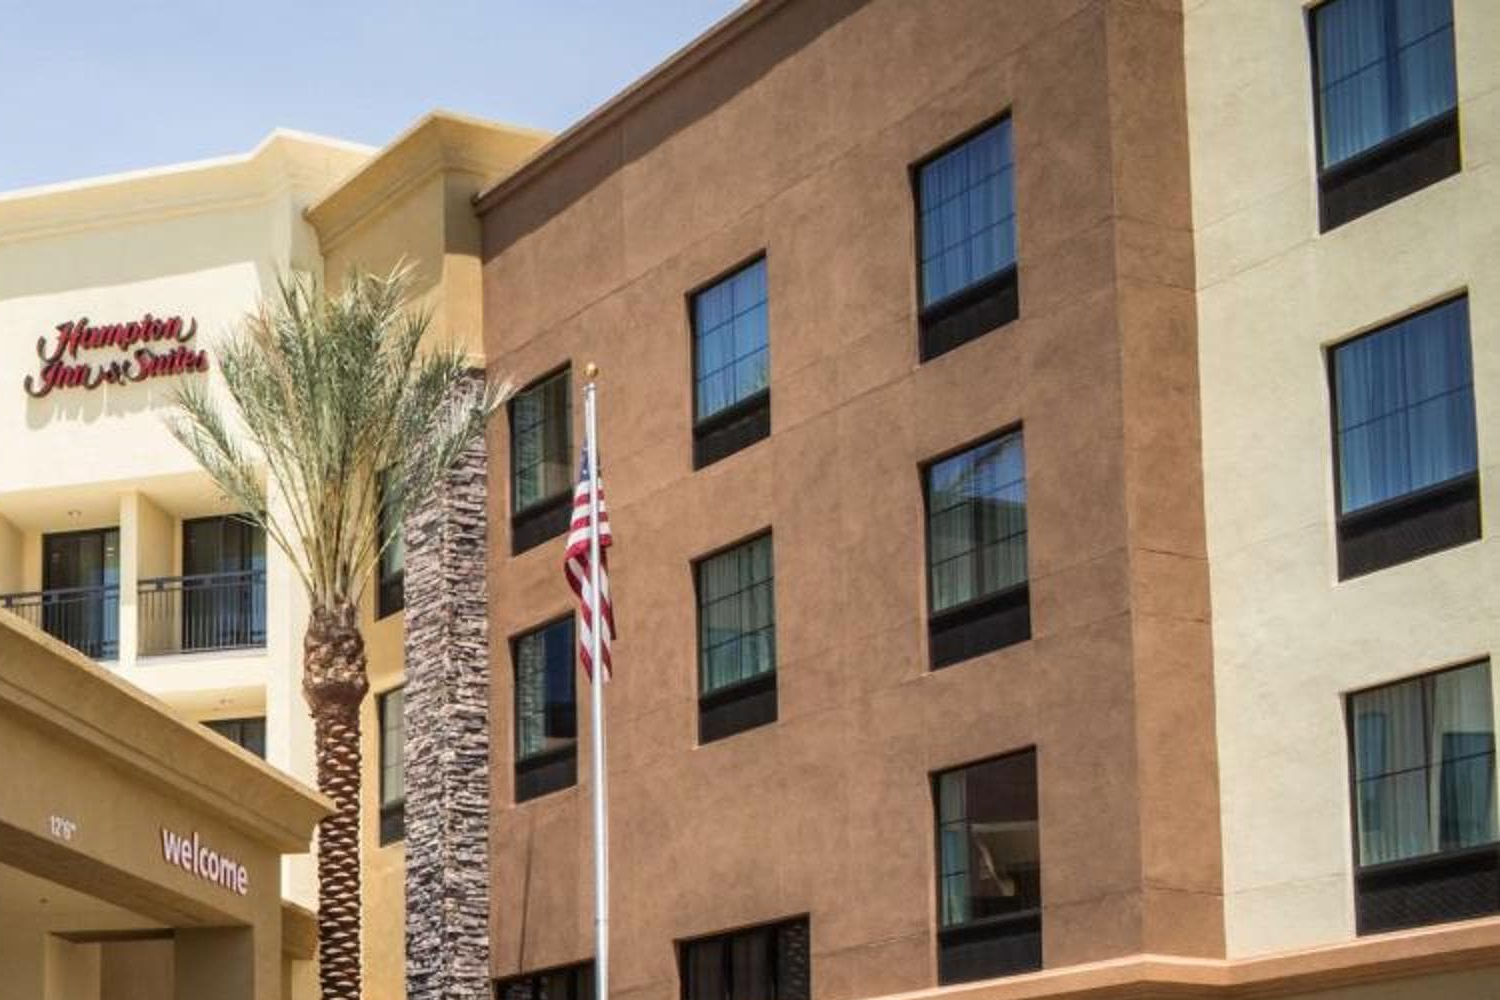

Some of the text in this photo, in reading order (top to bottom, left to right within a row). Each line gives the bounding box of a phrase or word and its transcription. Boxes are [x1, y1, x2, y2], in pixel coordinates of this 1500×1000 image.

[37, 313, 197, 360] Hampton
[24, 360, 103, 398] Inn
[121, 346, 209, 382] Suites
[161, 827, 249, 895] welcome
